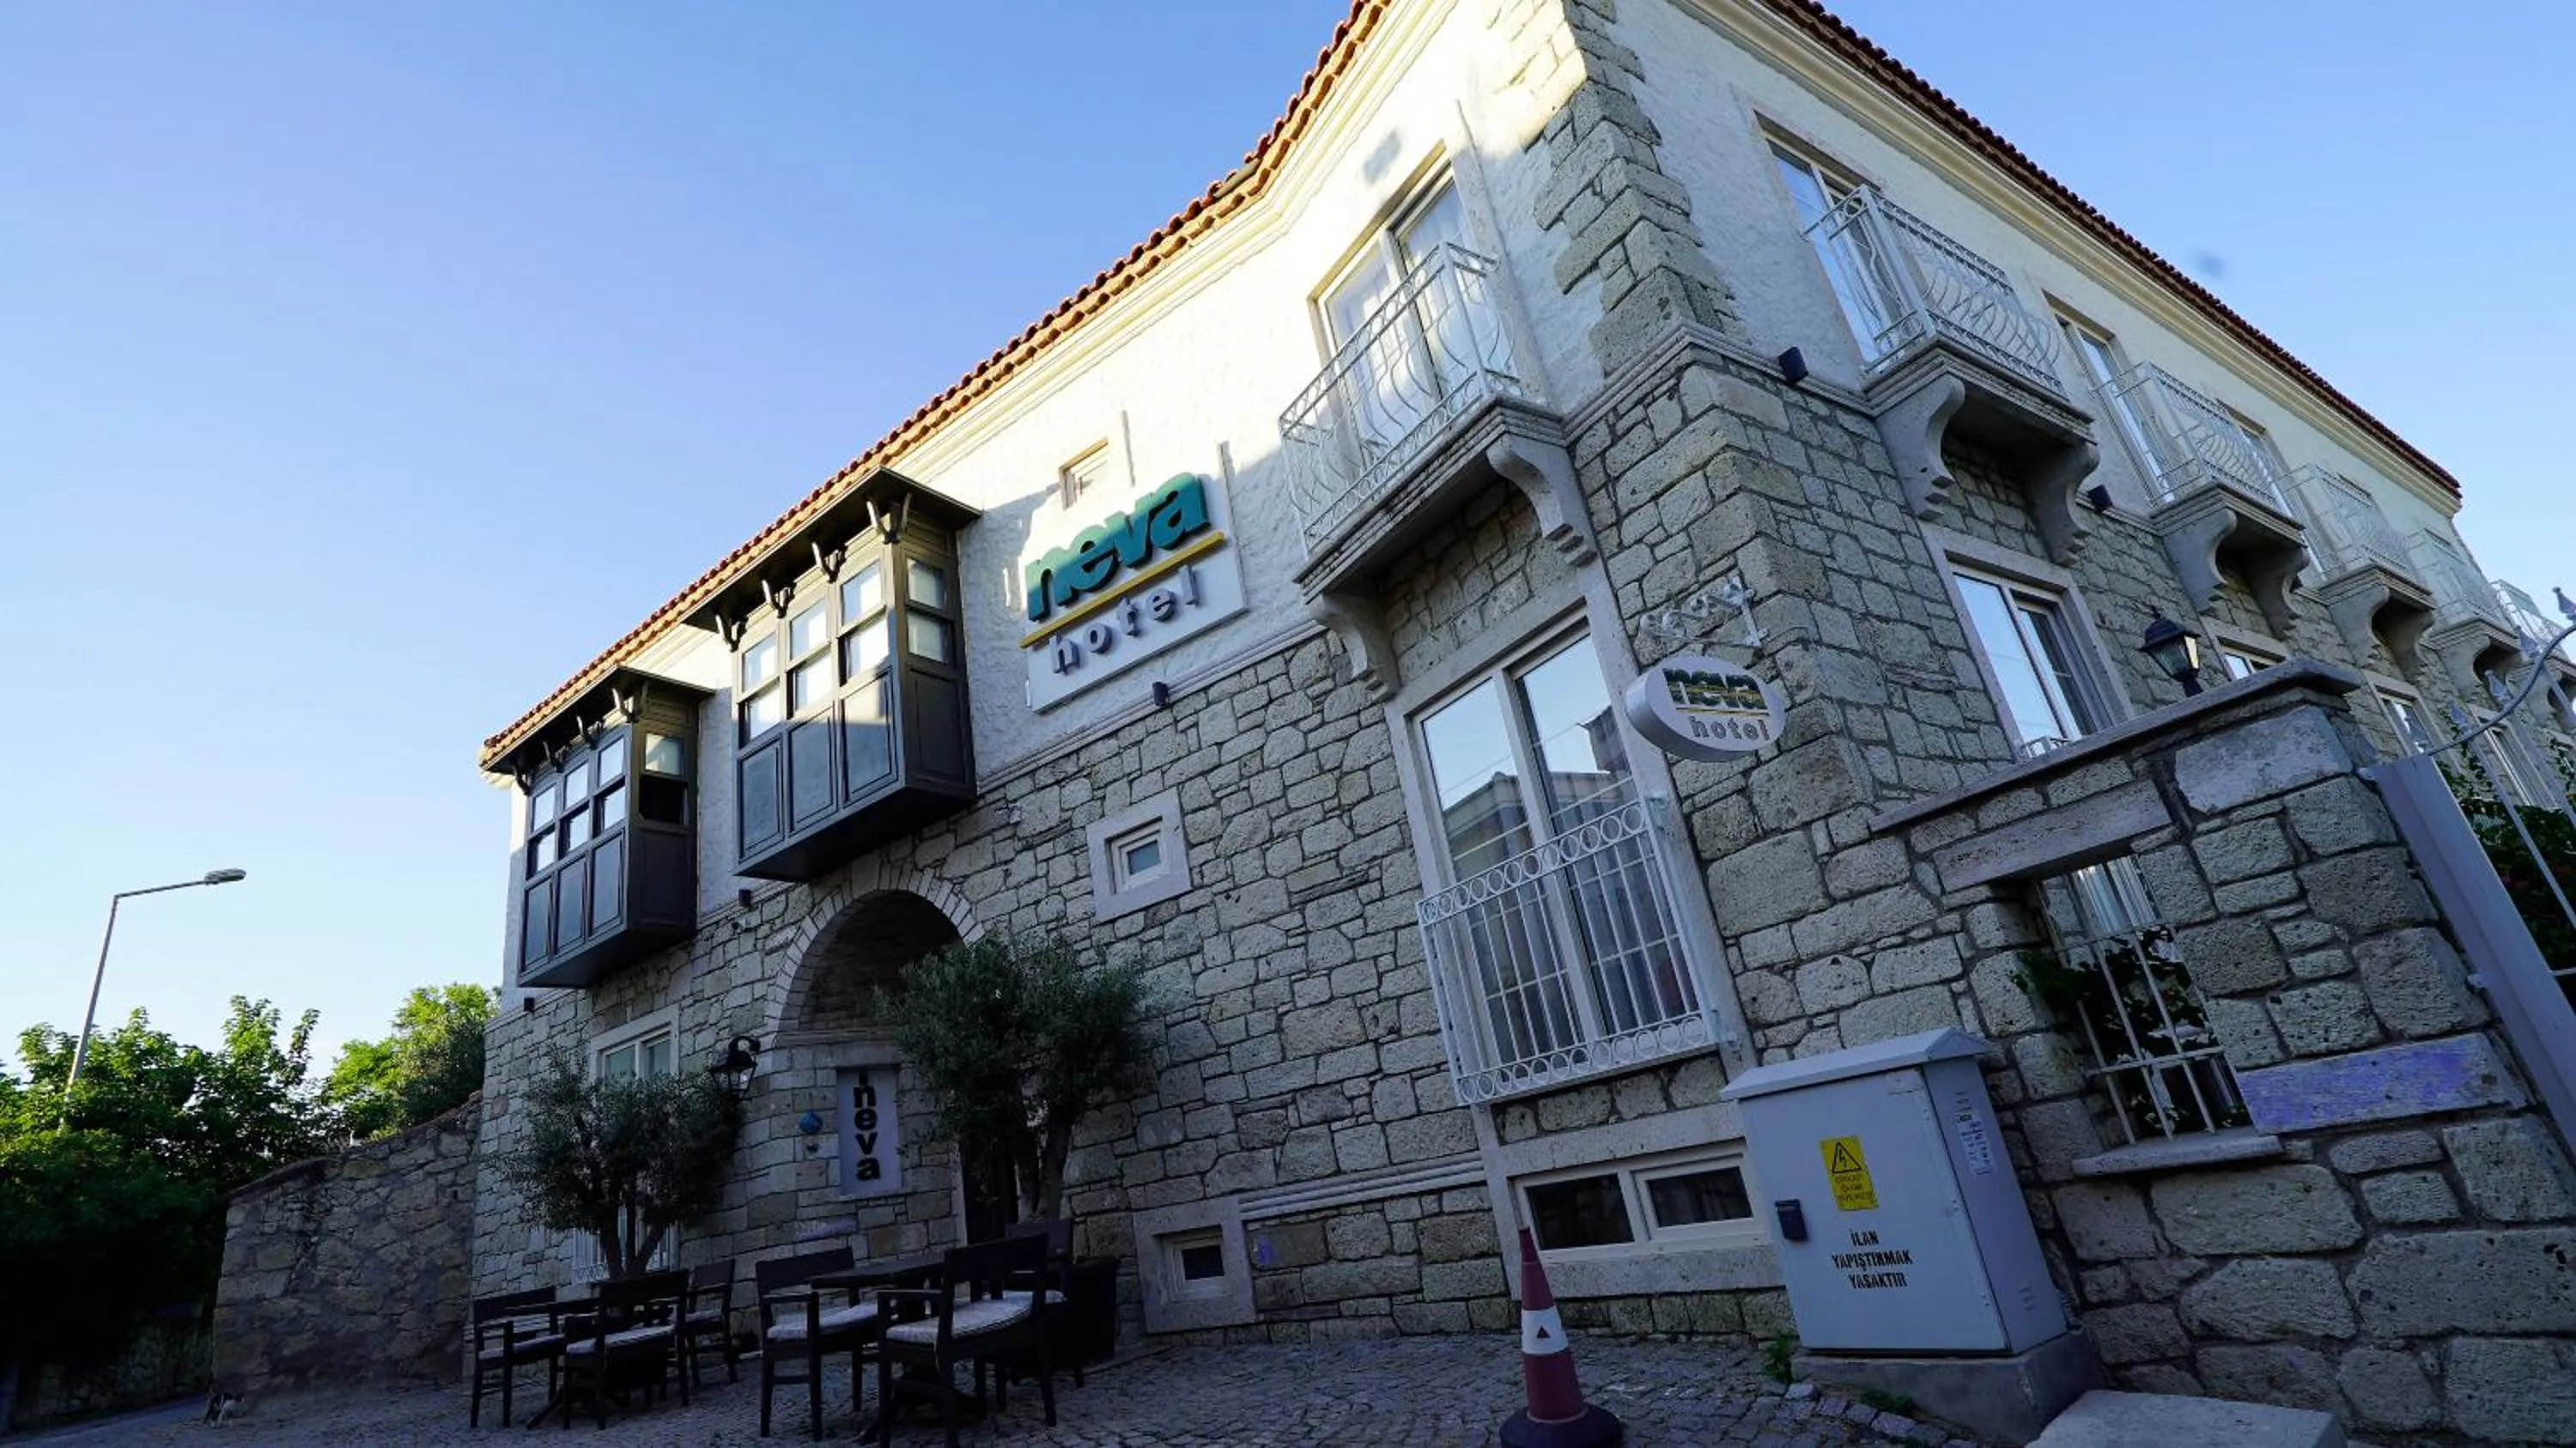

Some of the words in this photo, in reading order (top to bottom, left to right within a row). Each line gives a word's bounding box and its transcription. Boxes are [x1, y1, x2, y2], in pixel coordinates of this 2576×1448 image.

[1025, 472, 1211, 622] neva
[1048, 564, 1200, 675] hotel
[1689, 715, 1771, 741] hotel
[854, 1085, 881, 1182] neva
[1849, 1228, 1880, 1246] İLAN
[1831, 1250, 1915, 1271] YAPIŞTIRMAK
[1848, 1272, 1908, 1289] YASAKTIR
